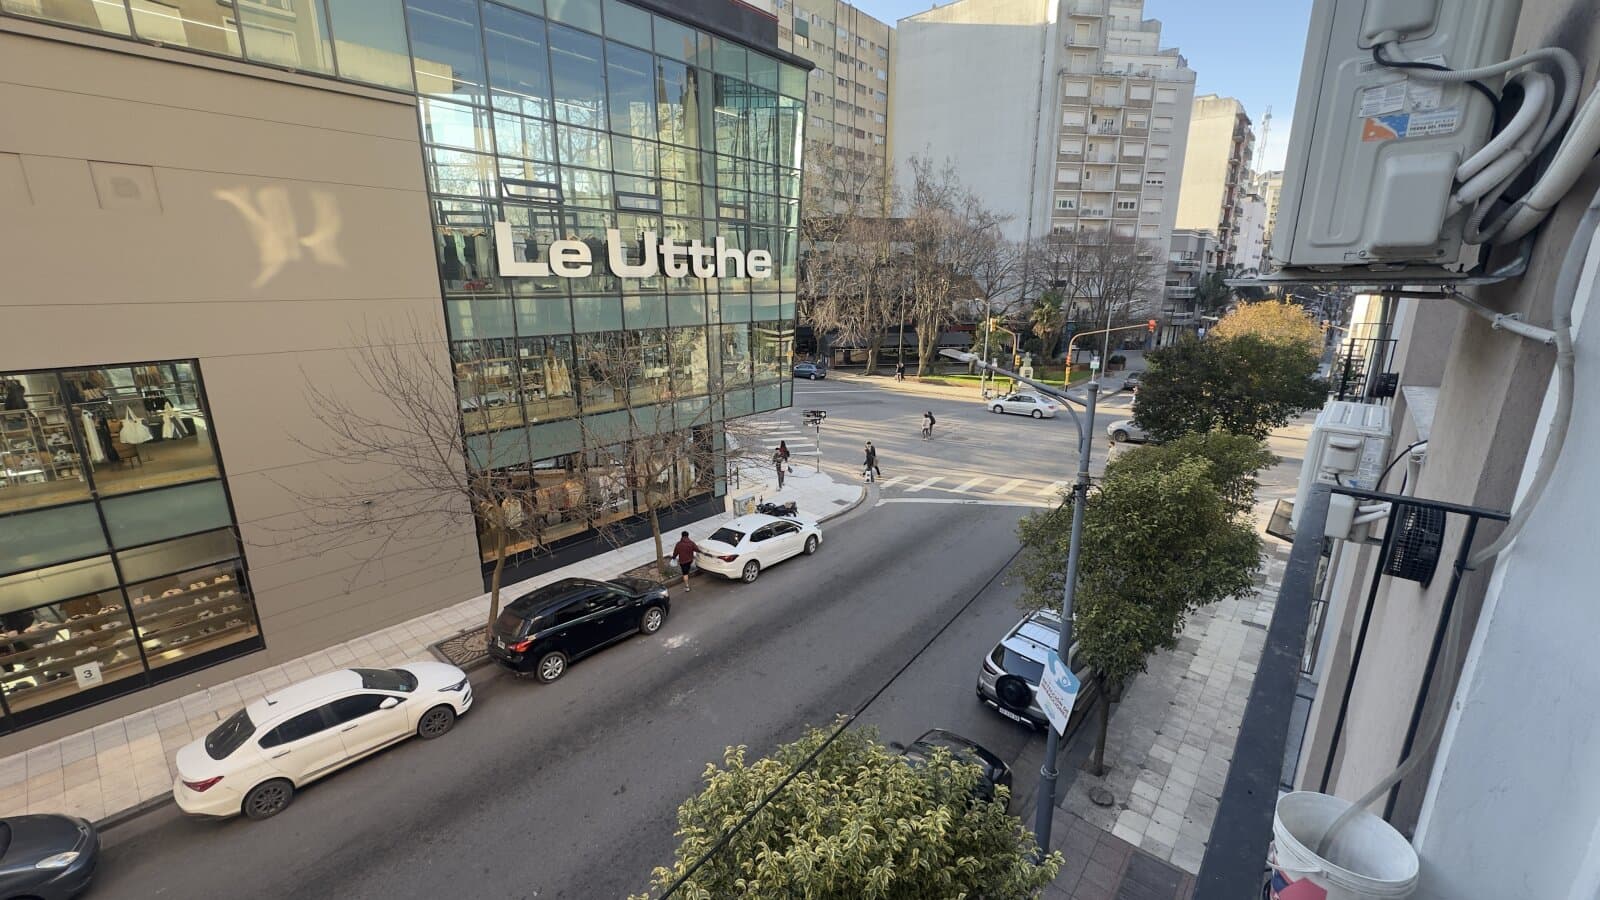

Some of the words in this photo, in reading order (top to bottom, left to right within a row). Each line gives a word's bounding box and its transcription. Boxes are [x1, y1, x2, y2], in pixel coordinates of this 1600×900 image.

[495, 221, 593, 277] Le
[607, 229, 772, 278] Utthe
[83, 669, 93, 679] 3
